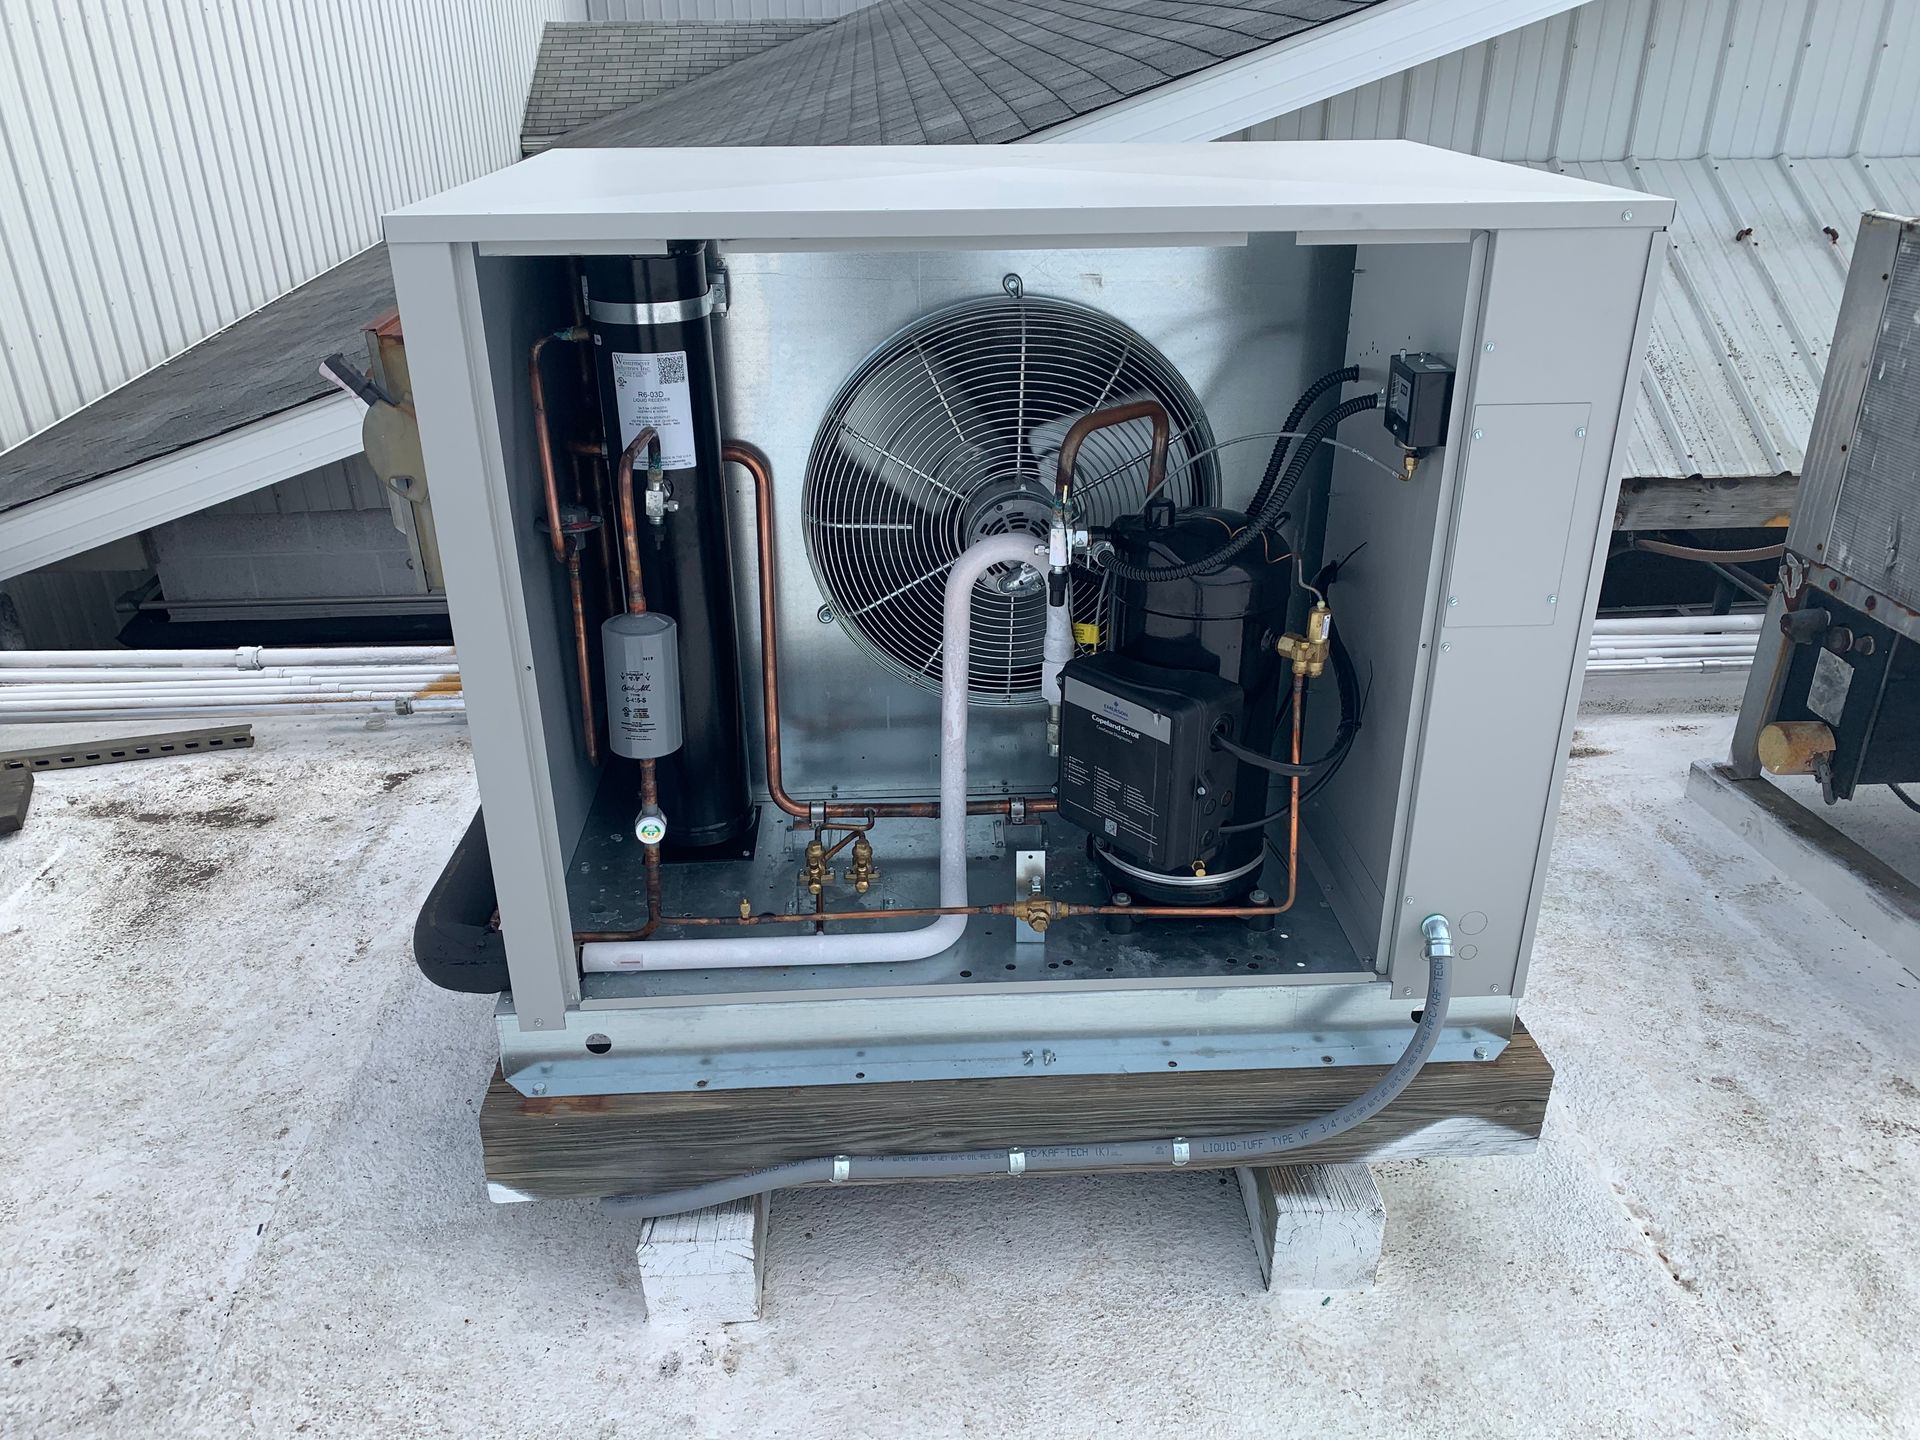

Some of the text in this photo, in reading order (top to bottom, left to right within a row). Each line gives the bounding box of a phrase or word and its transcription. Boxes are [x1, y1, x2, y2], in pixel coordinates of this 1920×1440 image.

[1091, 714, 1121, 732] Copeland
[1121, 726, 1141, 740] Scroll
[1025, 1147, 1089, 1158] FC/KAF-TECH
[1095, 1147, 1110, 1157] (K)
[1202, 1138, 1266, 1153] LIQUID-TUFF
[1272, 1133, 1294, 1146] TYPE
[1298, 1128, 1310, 1140] VF
